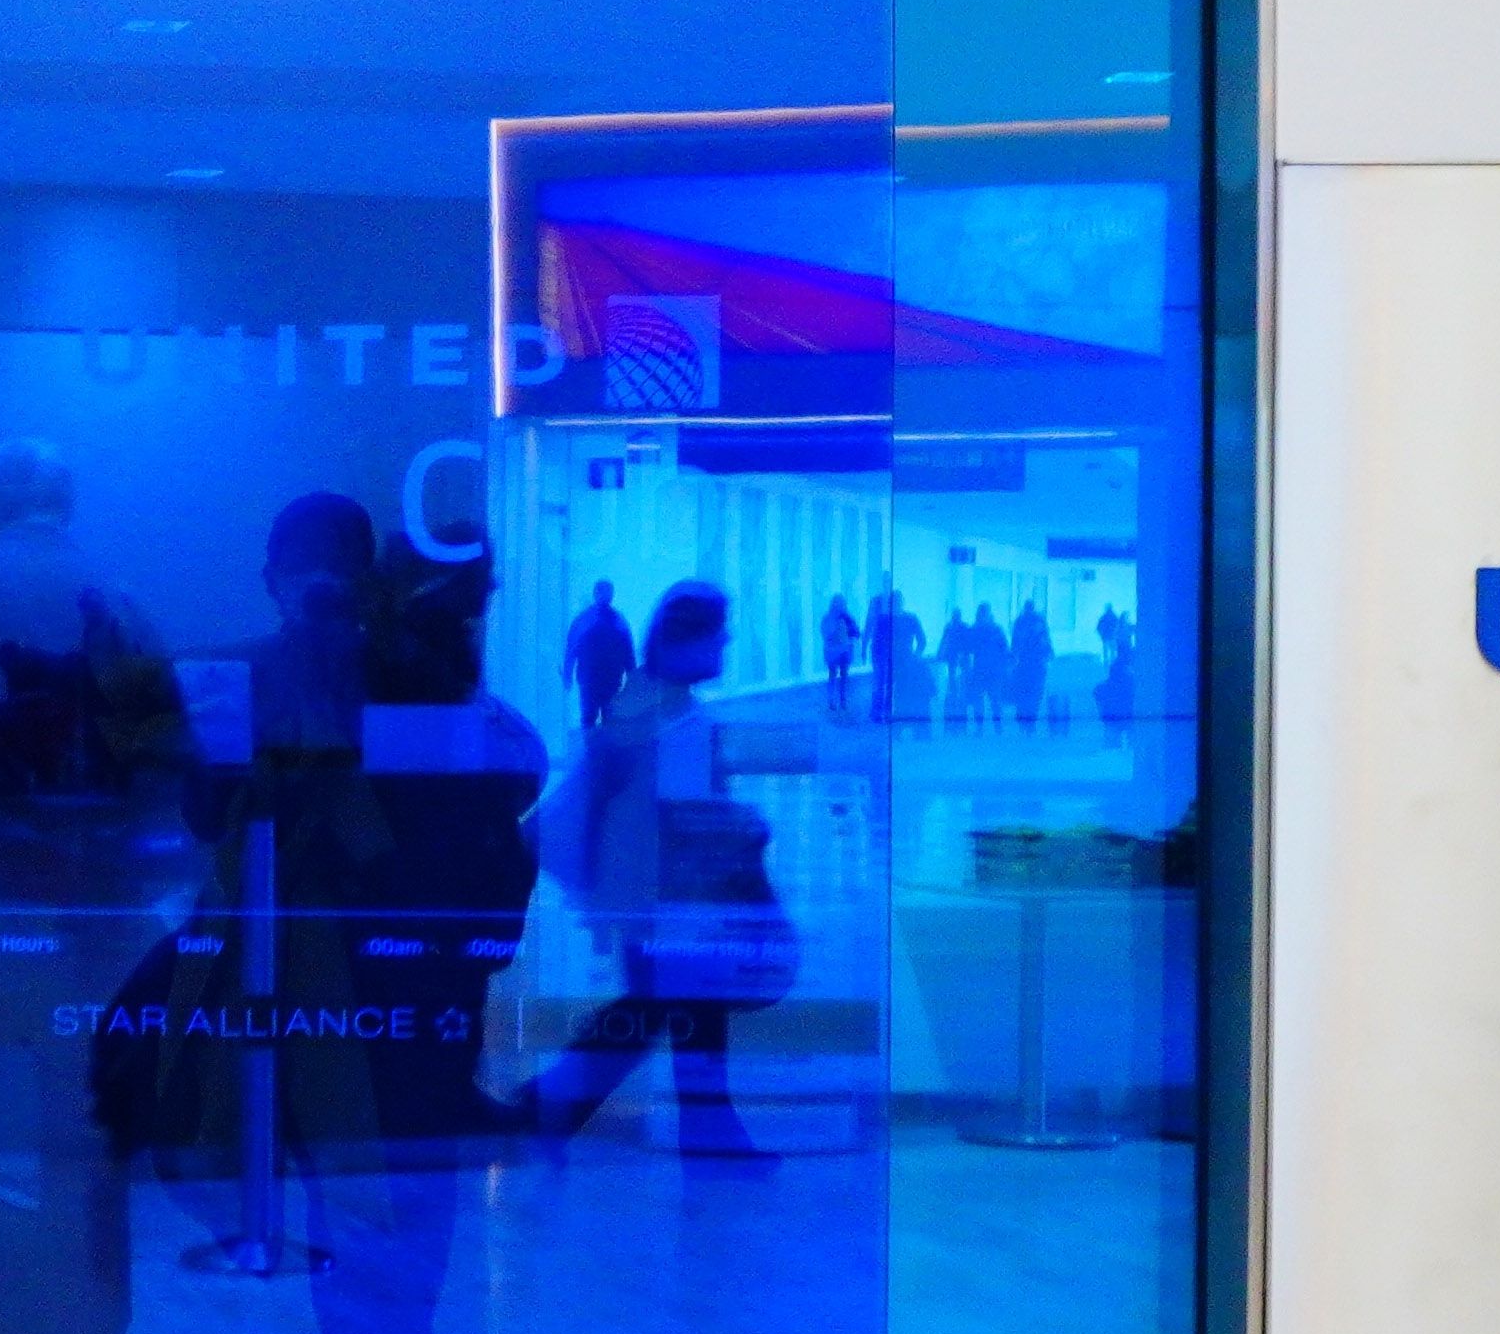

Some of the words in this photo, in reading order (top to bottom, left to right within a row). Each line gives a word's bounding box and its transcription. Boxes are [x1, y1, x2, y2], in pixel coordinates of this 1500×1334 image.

[177, 936, 225, 957] Daily
[52, 1003, 168, 1037] STAR
[185, 1005, 418, 1041] ALLIANCE
